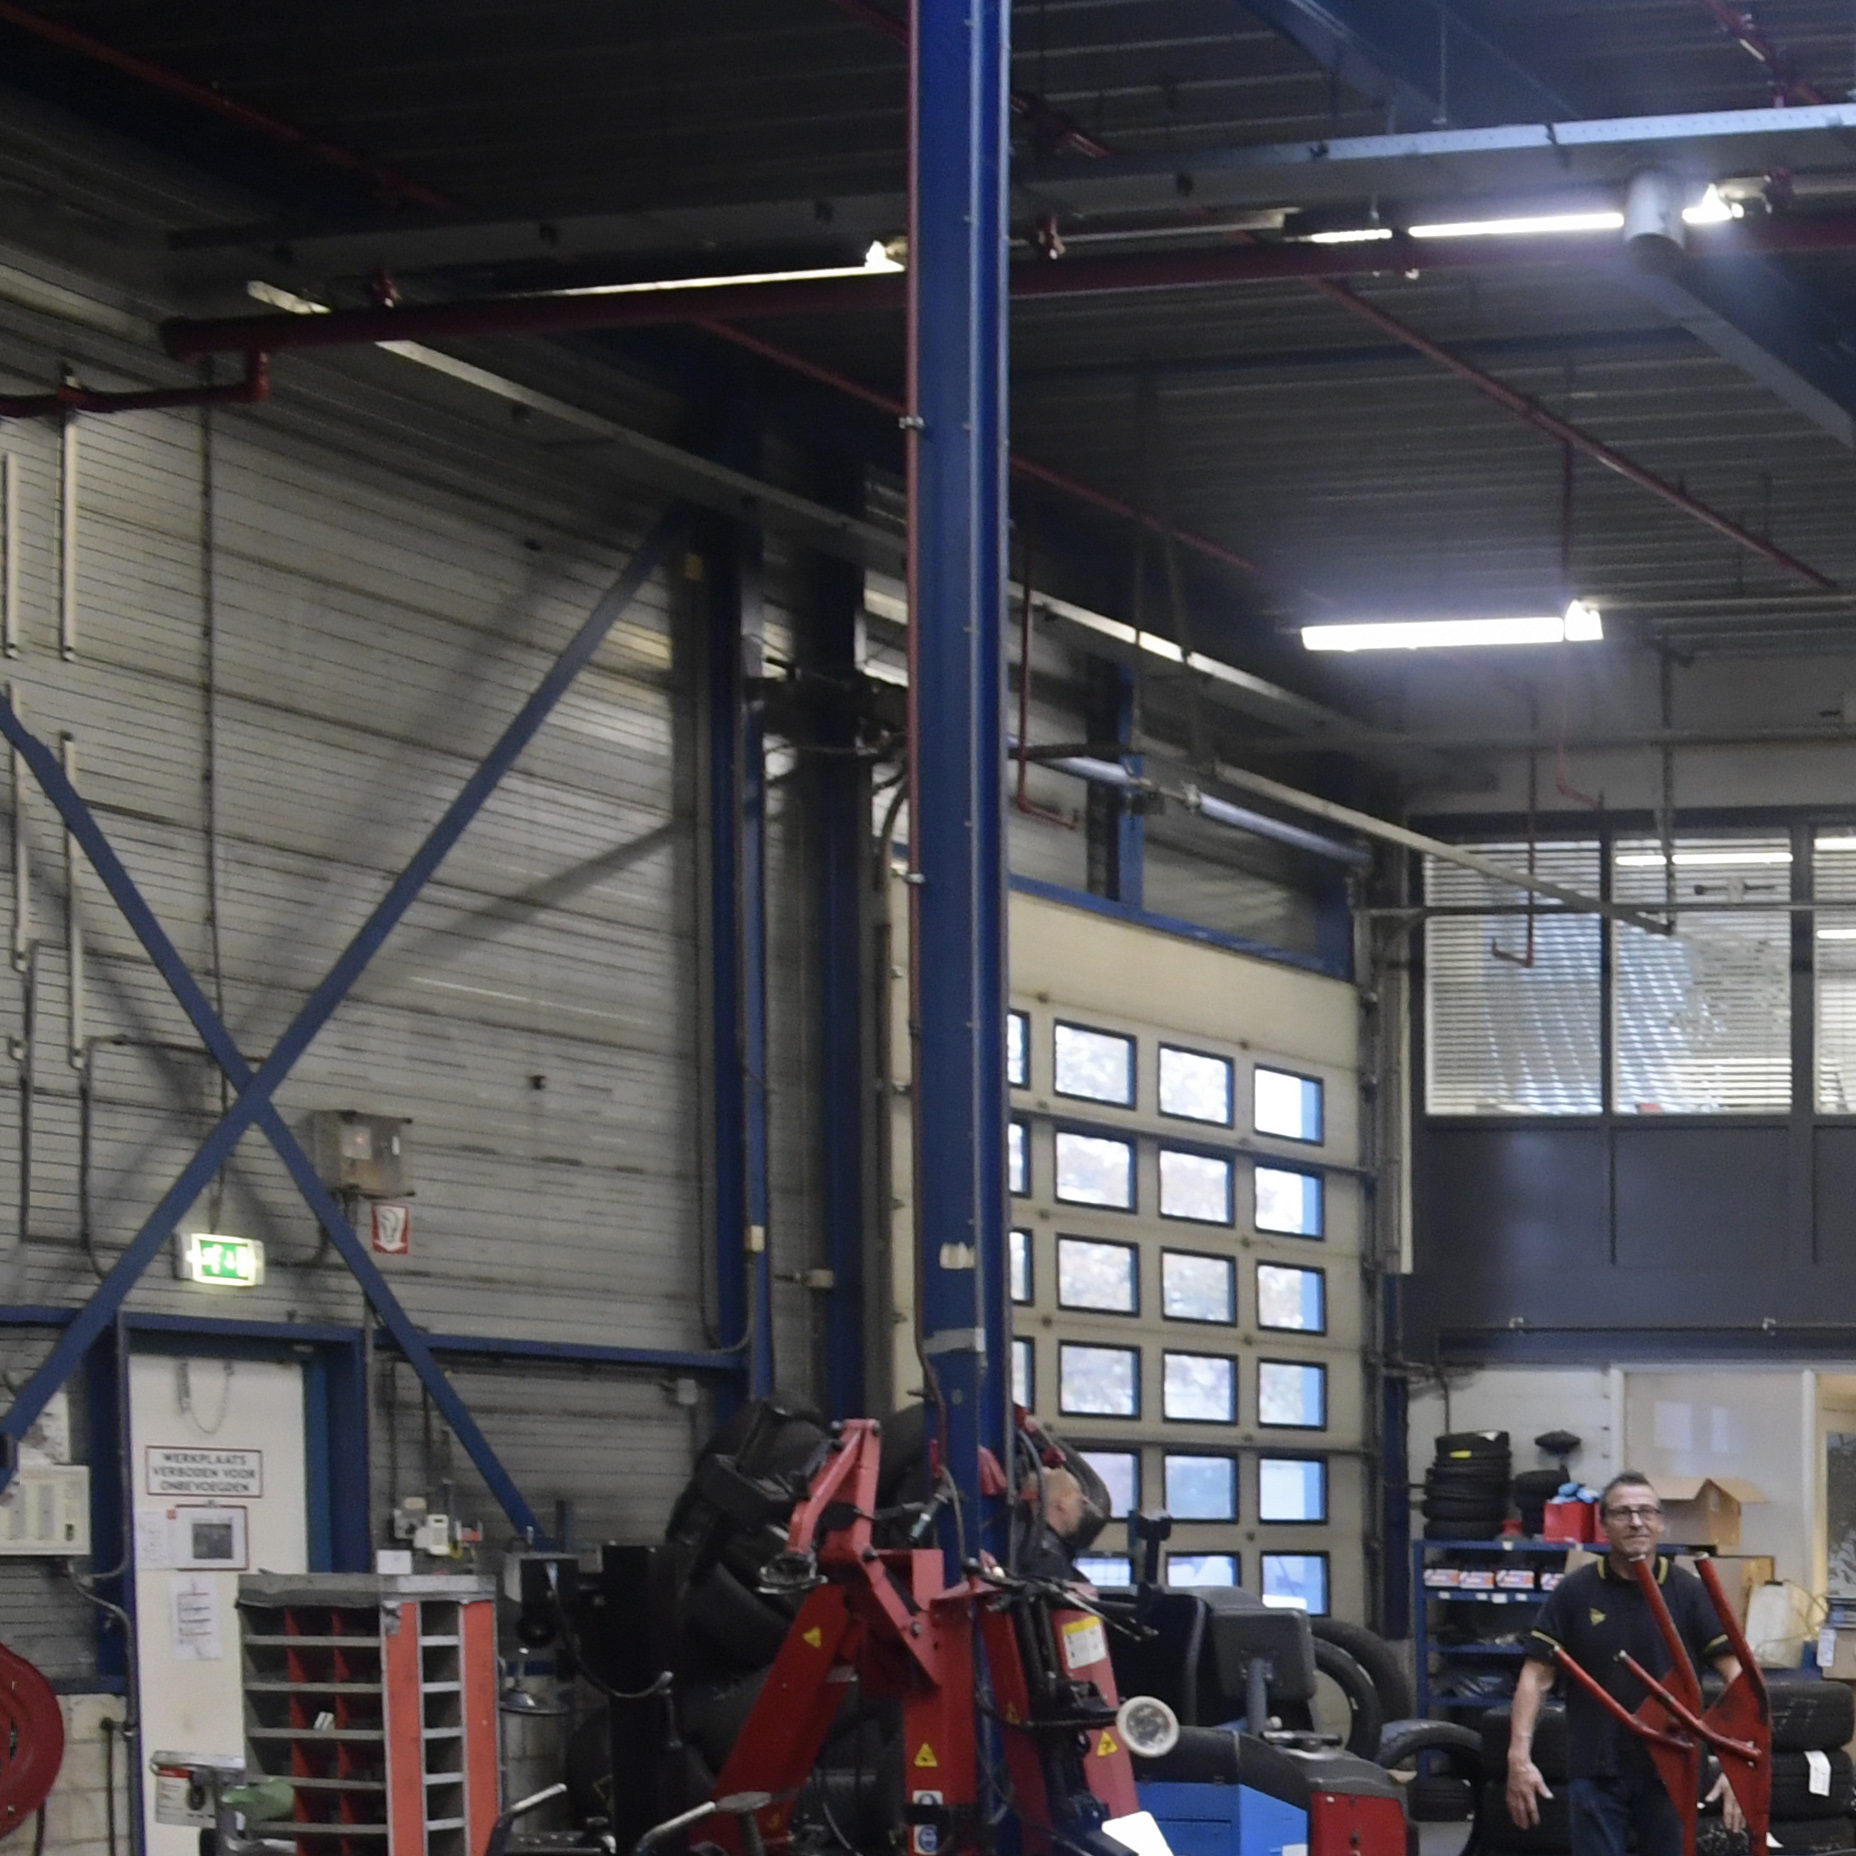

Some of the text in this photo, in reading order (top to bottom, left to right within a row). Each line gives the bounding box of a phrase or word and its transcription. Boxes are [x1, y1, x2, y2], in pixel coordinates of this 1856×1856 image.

[163, 1453, 247, 1465] WERKPLAATS
[152, 1466, 256, 1479] VERBODEN VOOR
[160, 1480, 250, 1493] ONBEVOEGDEN
